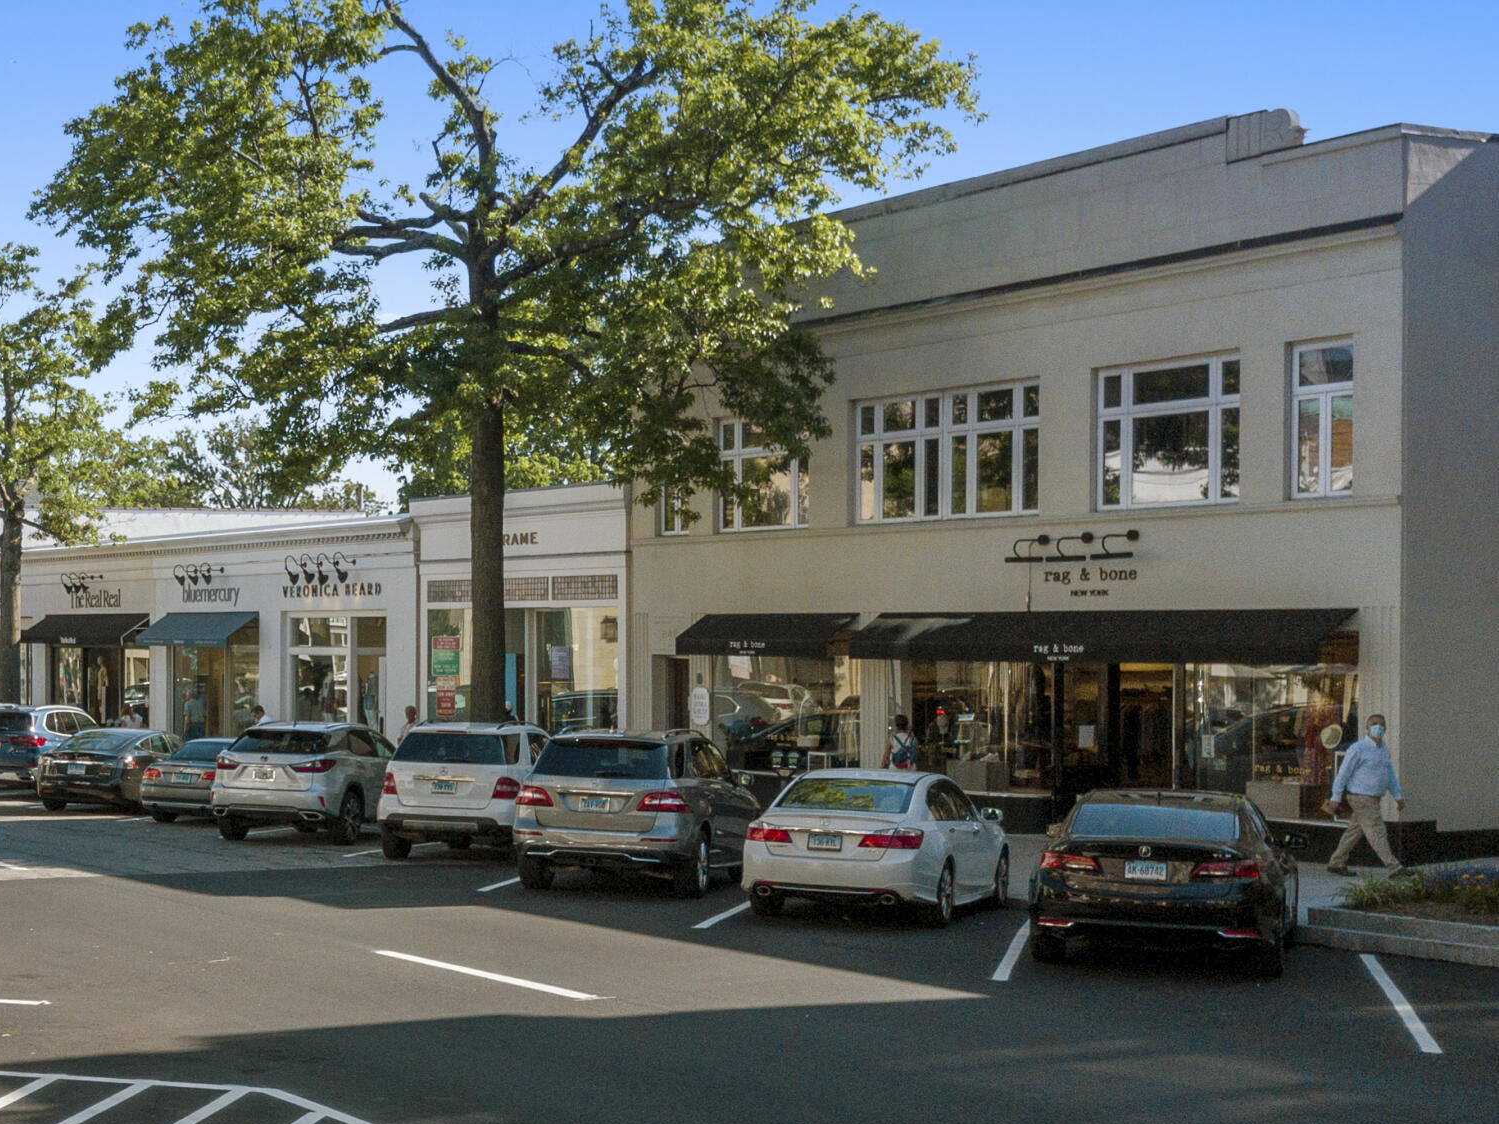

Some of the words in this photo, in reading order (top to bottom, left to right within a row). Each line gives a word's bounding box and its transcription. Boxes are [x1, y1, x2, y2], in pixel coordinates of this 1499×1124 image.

[502, 531, 539, 546] RAME
[1044, 570, 1071, 584] rag
[1080, 568, 1090, 580] &
[1100, 567, 1138, 581] bone
[182, 582, 240, 607] bluemercury
[283, 583, 339, 598] VERONICA
[345, 582, 382, 596] BEARD
[1070, 589, 1087, 597] NEW
[1033, 644, 1048, 654] rag
[1063, 643, 1084, 653] bone
